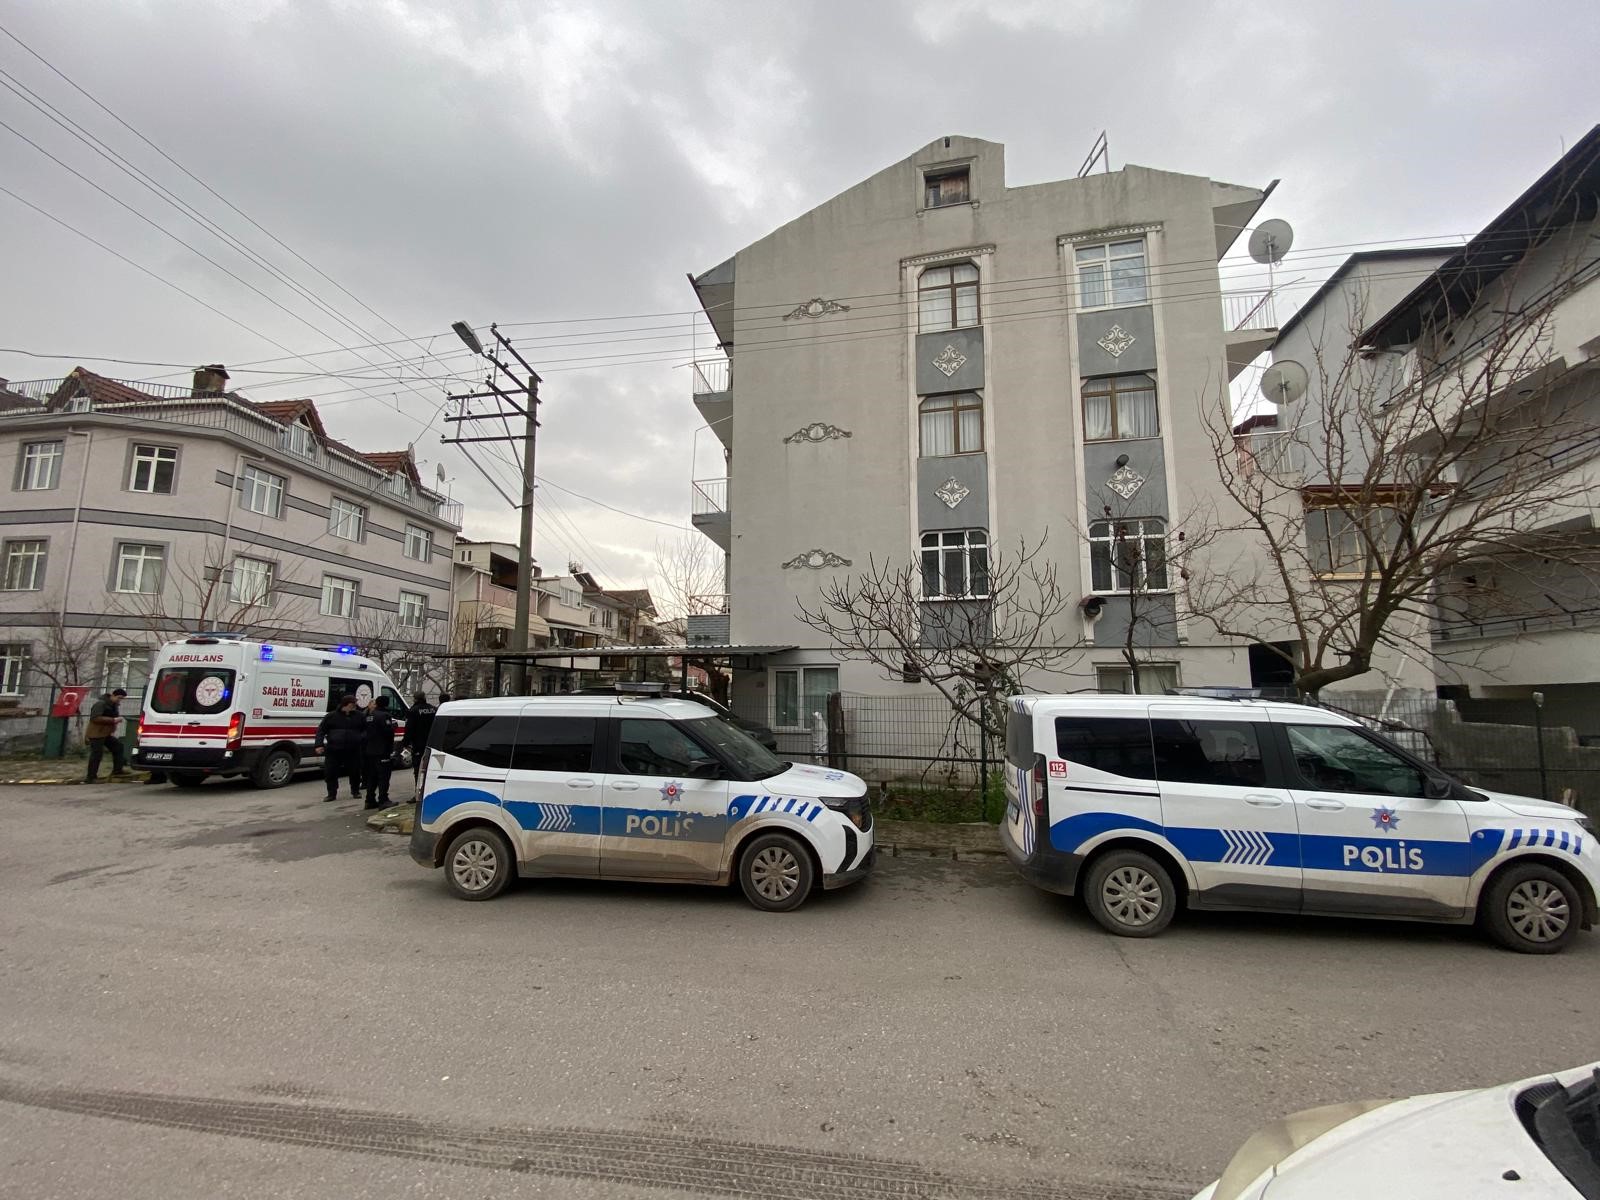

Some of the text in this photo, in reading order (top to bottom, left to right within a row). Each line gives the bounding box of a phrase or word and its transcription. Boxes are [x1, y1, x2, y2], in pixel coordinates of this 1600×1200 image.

[168, 654, 224, 663] AMBULANS
[290, 678, 303, 688] T.C.
[262, 686, 326, 698] SAĞLIK BAKANLIĞI
[272, 697, 315, 708] ACİL SAĞLIK
[1051, 762, 1065, 772] 112
[1343, 841, 1424, 872] POLİS
